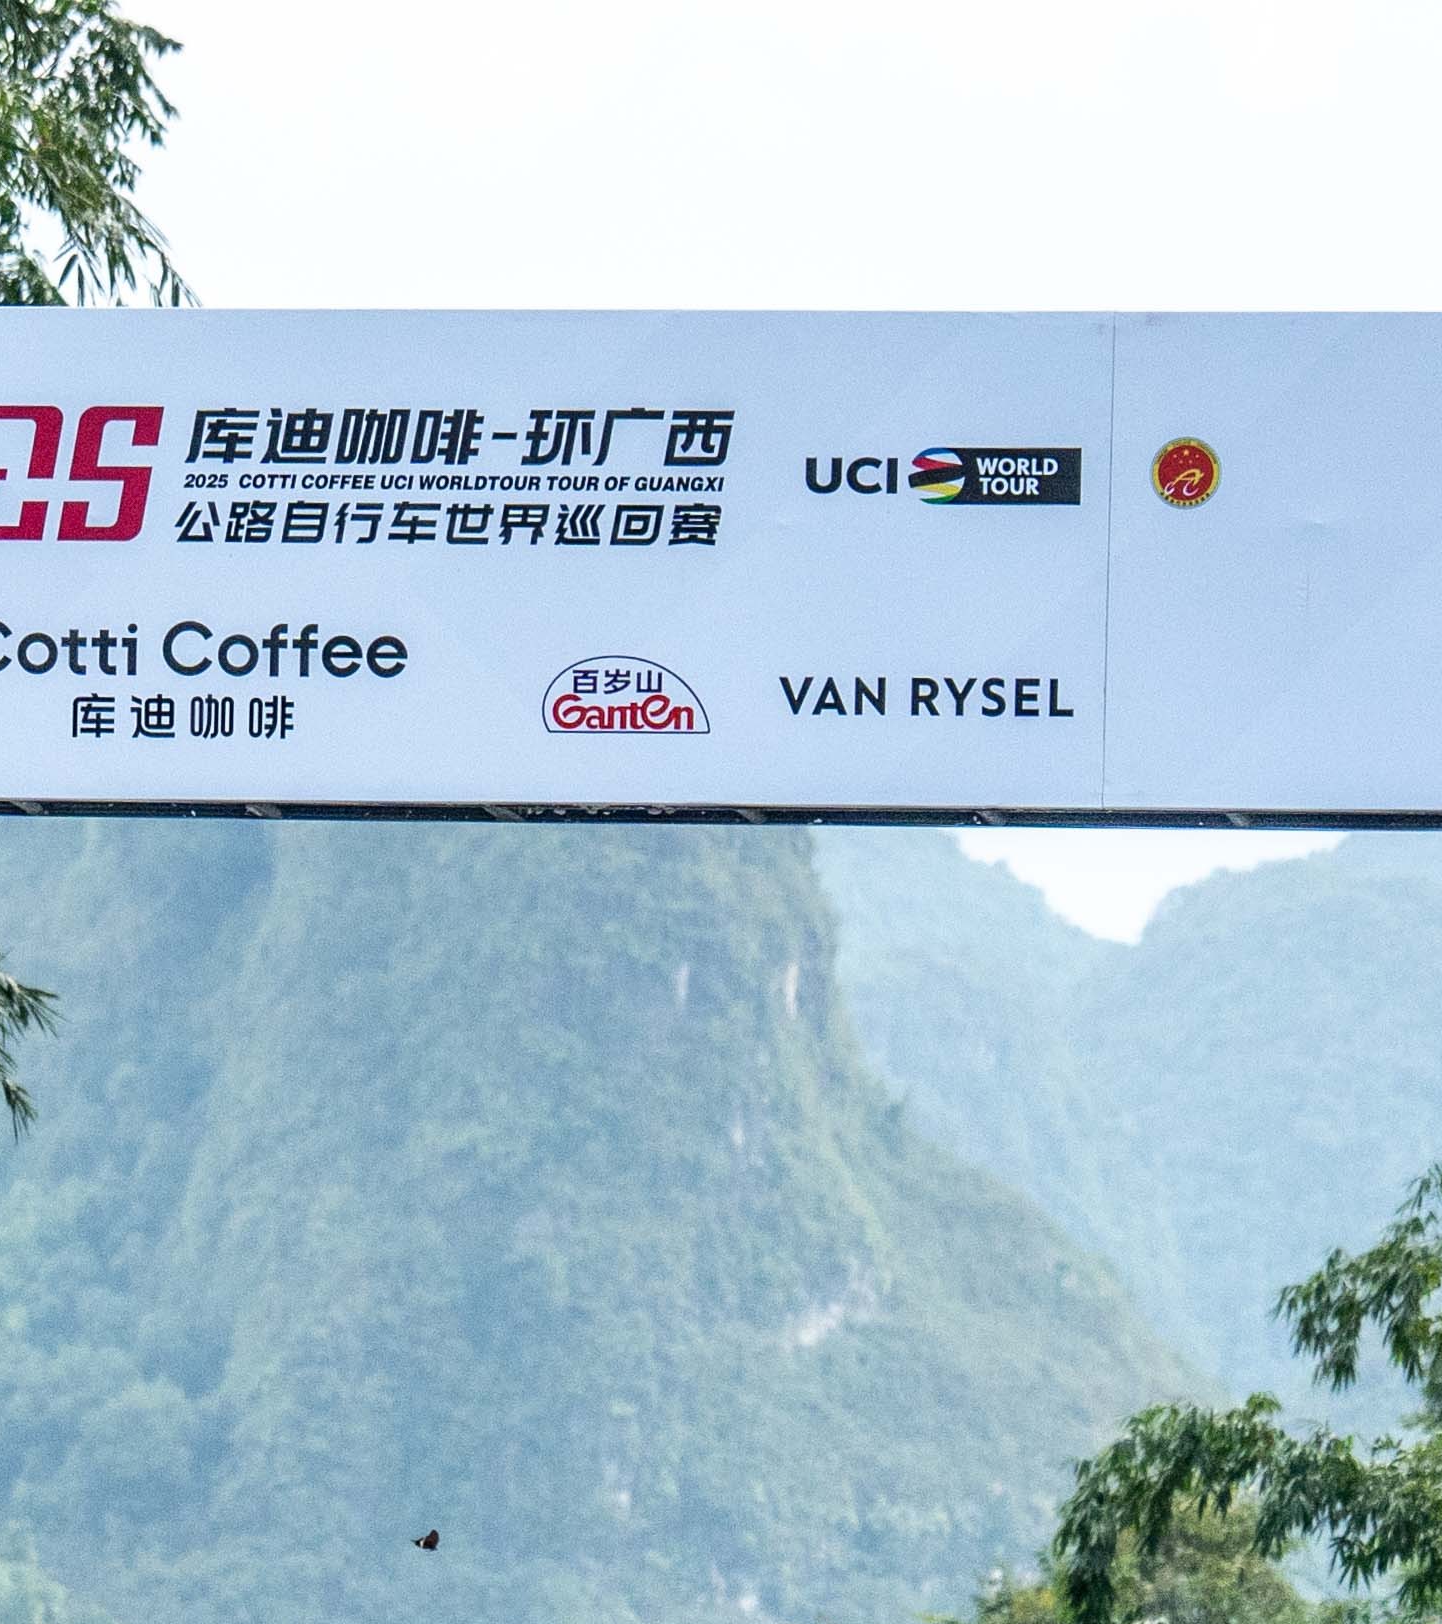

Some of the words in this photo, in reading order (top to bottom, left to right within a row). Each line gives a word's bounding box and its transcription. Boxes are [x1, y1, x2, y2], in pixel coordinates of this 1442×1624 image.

[185, 407, 735, 466] 库迪咖啡-环广西
[183, 474, 229, 489] 2025
[239, 474, 296, 489] COTTI
[301, 475, 376, 490] COFFEE
[381, 475, 414, 490] UCI
[419, 475, 542, 491] WORLDTOUR
[547, 476, 593, 491] TOUR
[598, 477, 630, 492] OF
[635, 477, 725, 492] GUANGXI
[805, 457, 899, 495] UCI
[976, 458, 1059, 476] WORLD
[979, 477, 1040, 496] TOUR
[176, 501, 722, 546] 公路自行车世界巡回赛
[162, 620, 408, 678] Coffee
[571, 669, 663, 696] 百岁山
[779, 677, 887, 716] VAN
[910, 677, 1074, 718] RYSEL
[71, 692, 295, 740] 库迪咖啡
[551, 693, 697, 733] Ganten
